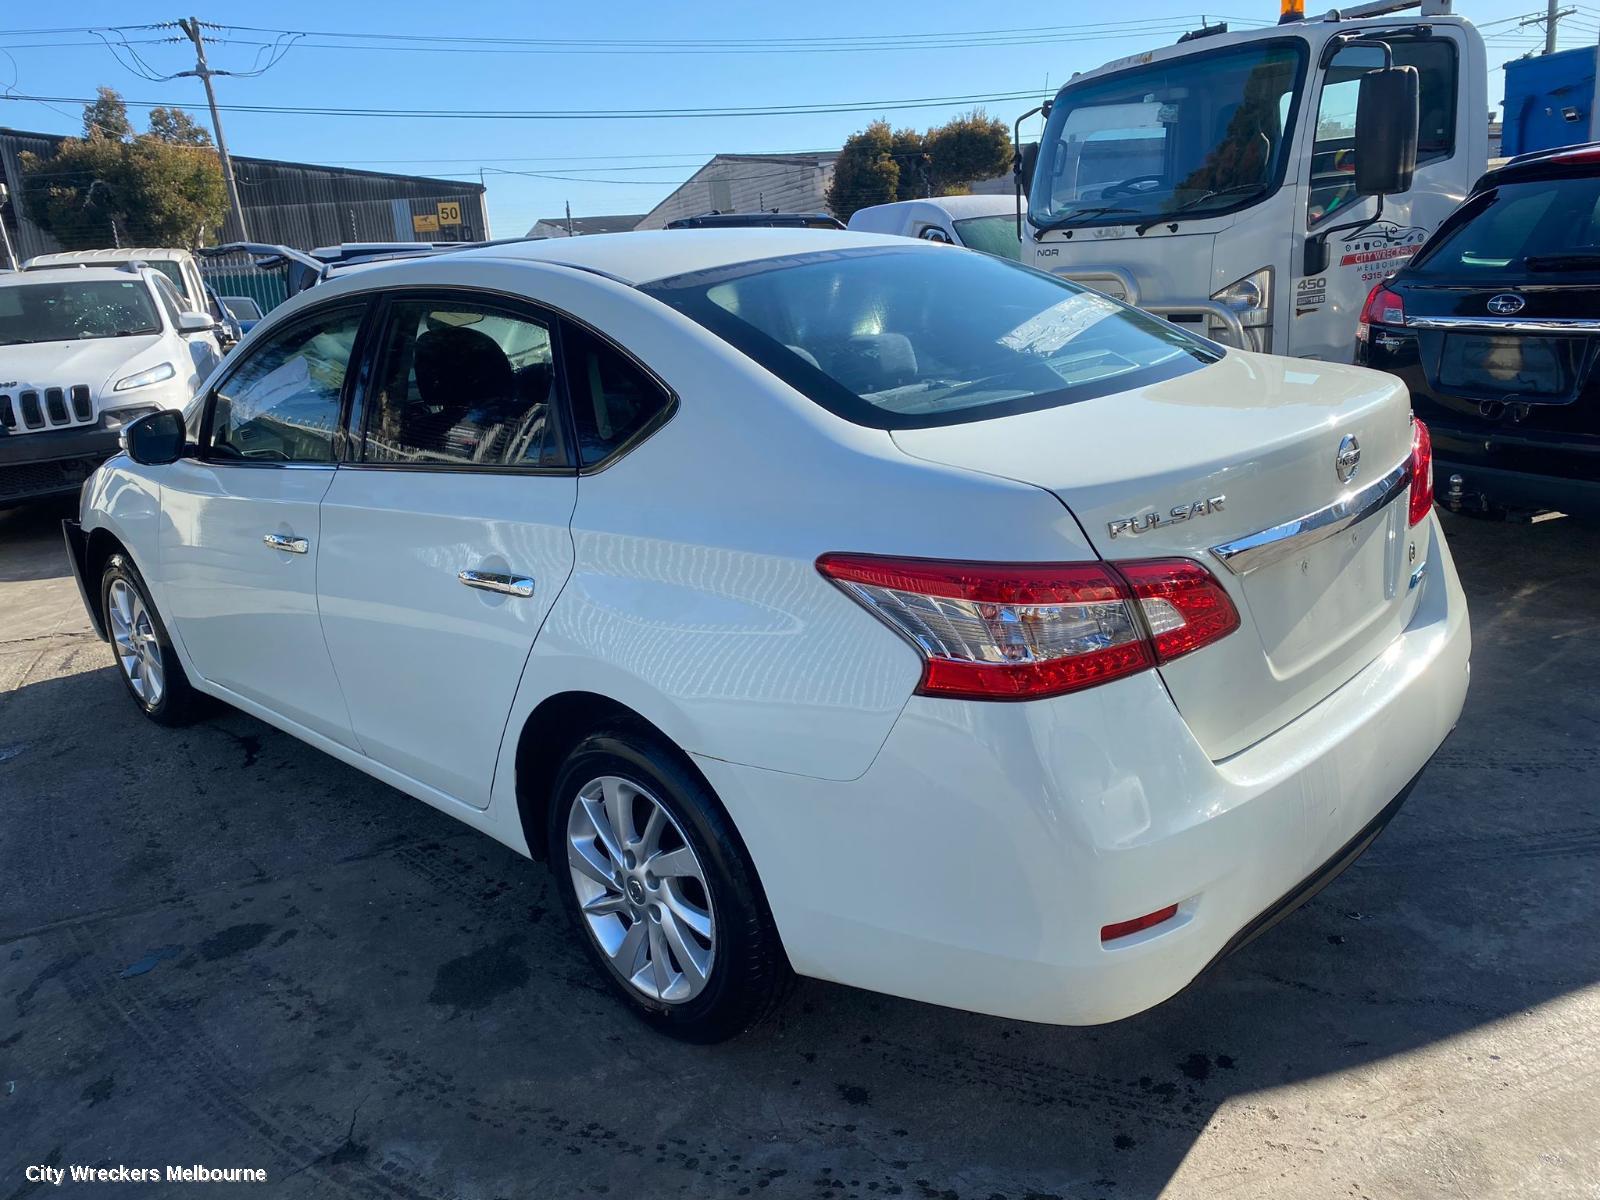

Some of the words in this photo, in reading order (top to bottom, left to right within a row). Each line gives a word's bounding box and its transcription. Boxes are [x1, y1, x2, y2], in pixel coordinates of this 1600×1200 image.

[441, 207, 458, 220] 50
[1355, 251, 1374, 263] CITY
[1361, 271, 1382, 281] 9315
[1297, 277, 1327, 290] 450
[1108, 494, 1226, 539] PULSAR
